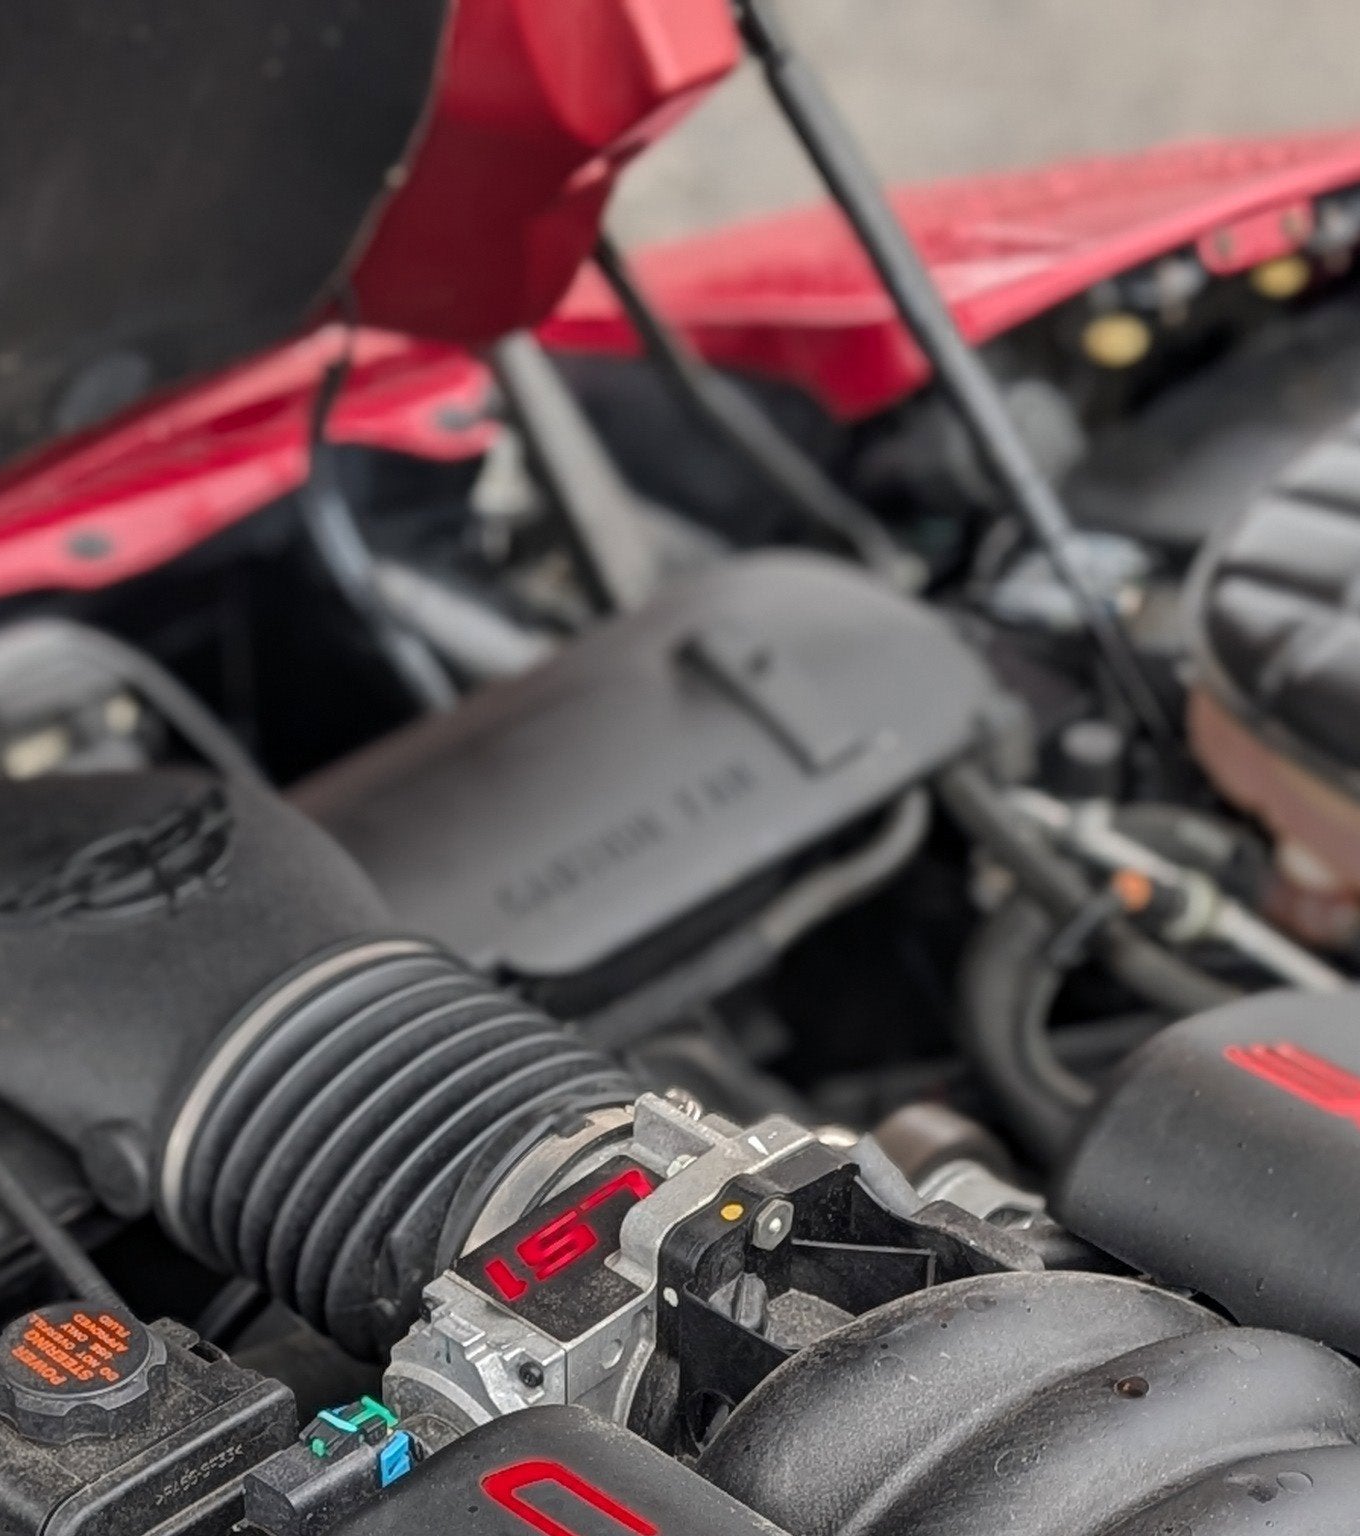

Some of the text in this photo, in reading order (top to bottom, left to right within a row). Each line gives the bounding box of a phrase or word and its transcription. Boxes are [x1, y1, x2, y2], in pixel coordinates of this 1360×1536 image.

[482, 1168, 655, 1302] LS1
[60, 1322, 113, 1360] USE ONLY
[73, 1313, 129, 1352] APPROVED
[98, 1314, 131, 1338] FLUID
[11, 1345, 67, 1386] POWER
[24, 1329, 94, 1380] STEERING
[29, 1313, 120, 1382] DO NOT OVERFILL
